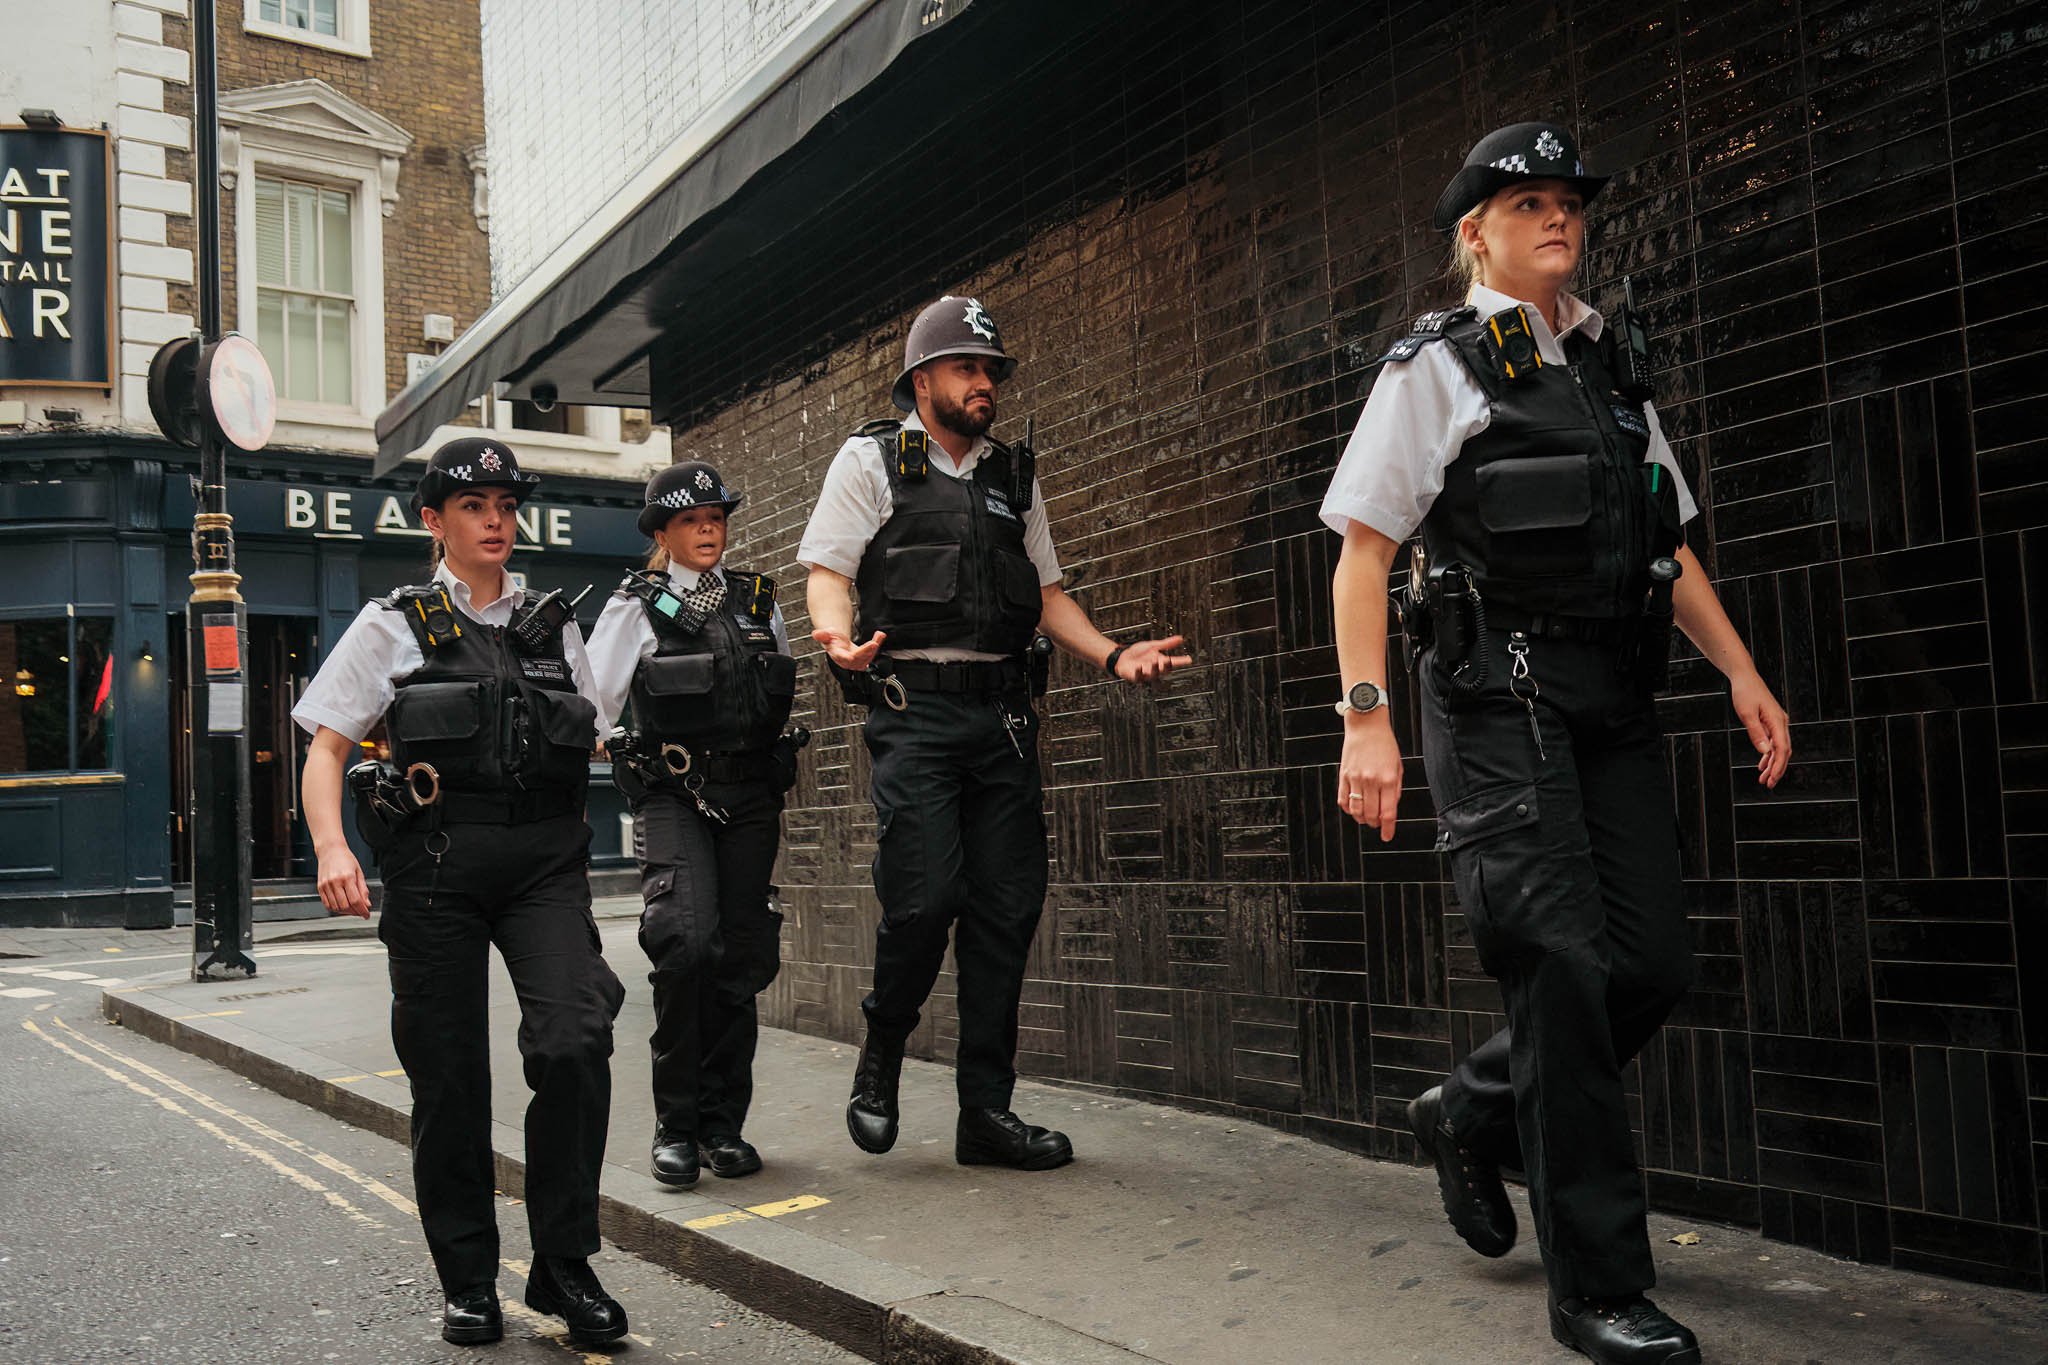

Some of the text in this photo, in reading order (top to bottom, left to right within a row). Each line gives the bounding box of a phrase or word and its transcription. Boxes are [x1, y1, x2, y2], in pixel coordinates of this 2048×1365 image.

[0, 168, 70, 197] AT
[0, 288, 72, 339] R
[286, 488, 352, 532] BE
[515, 506, 572, 546] NE
